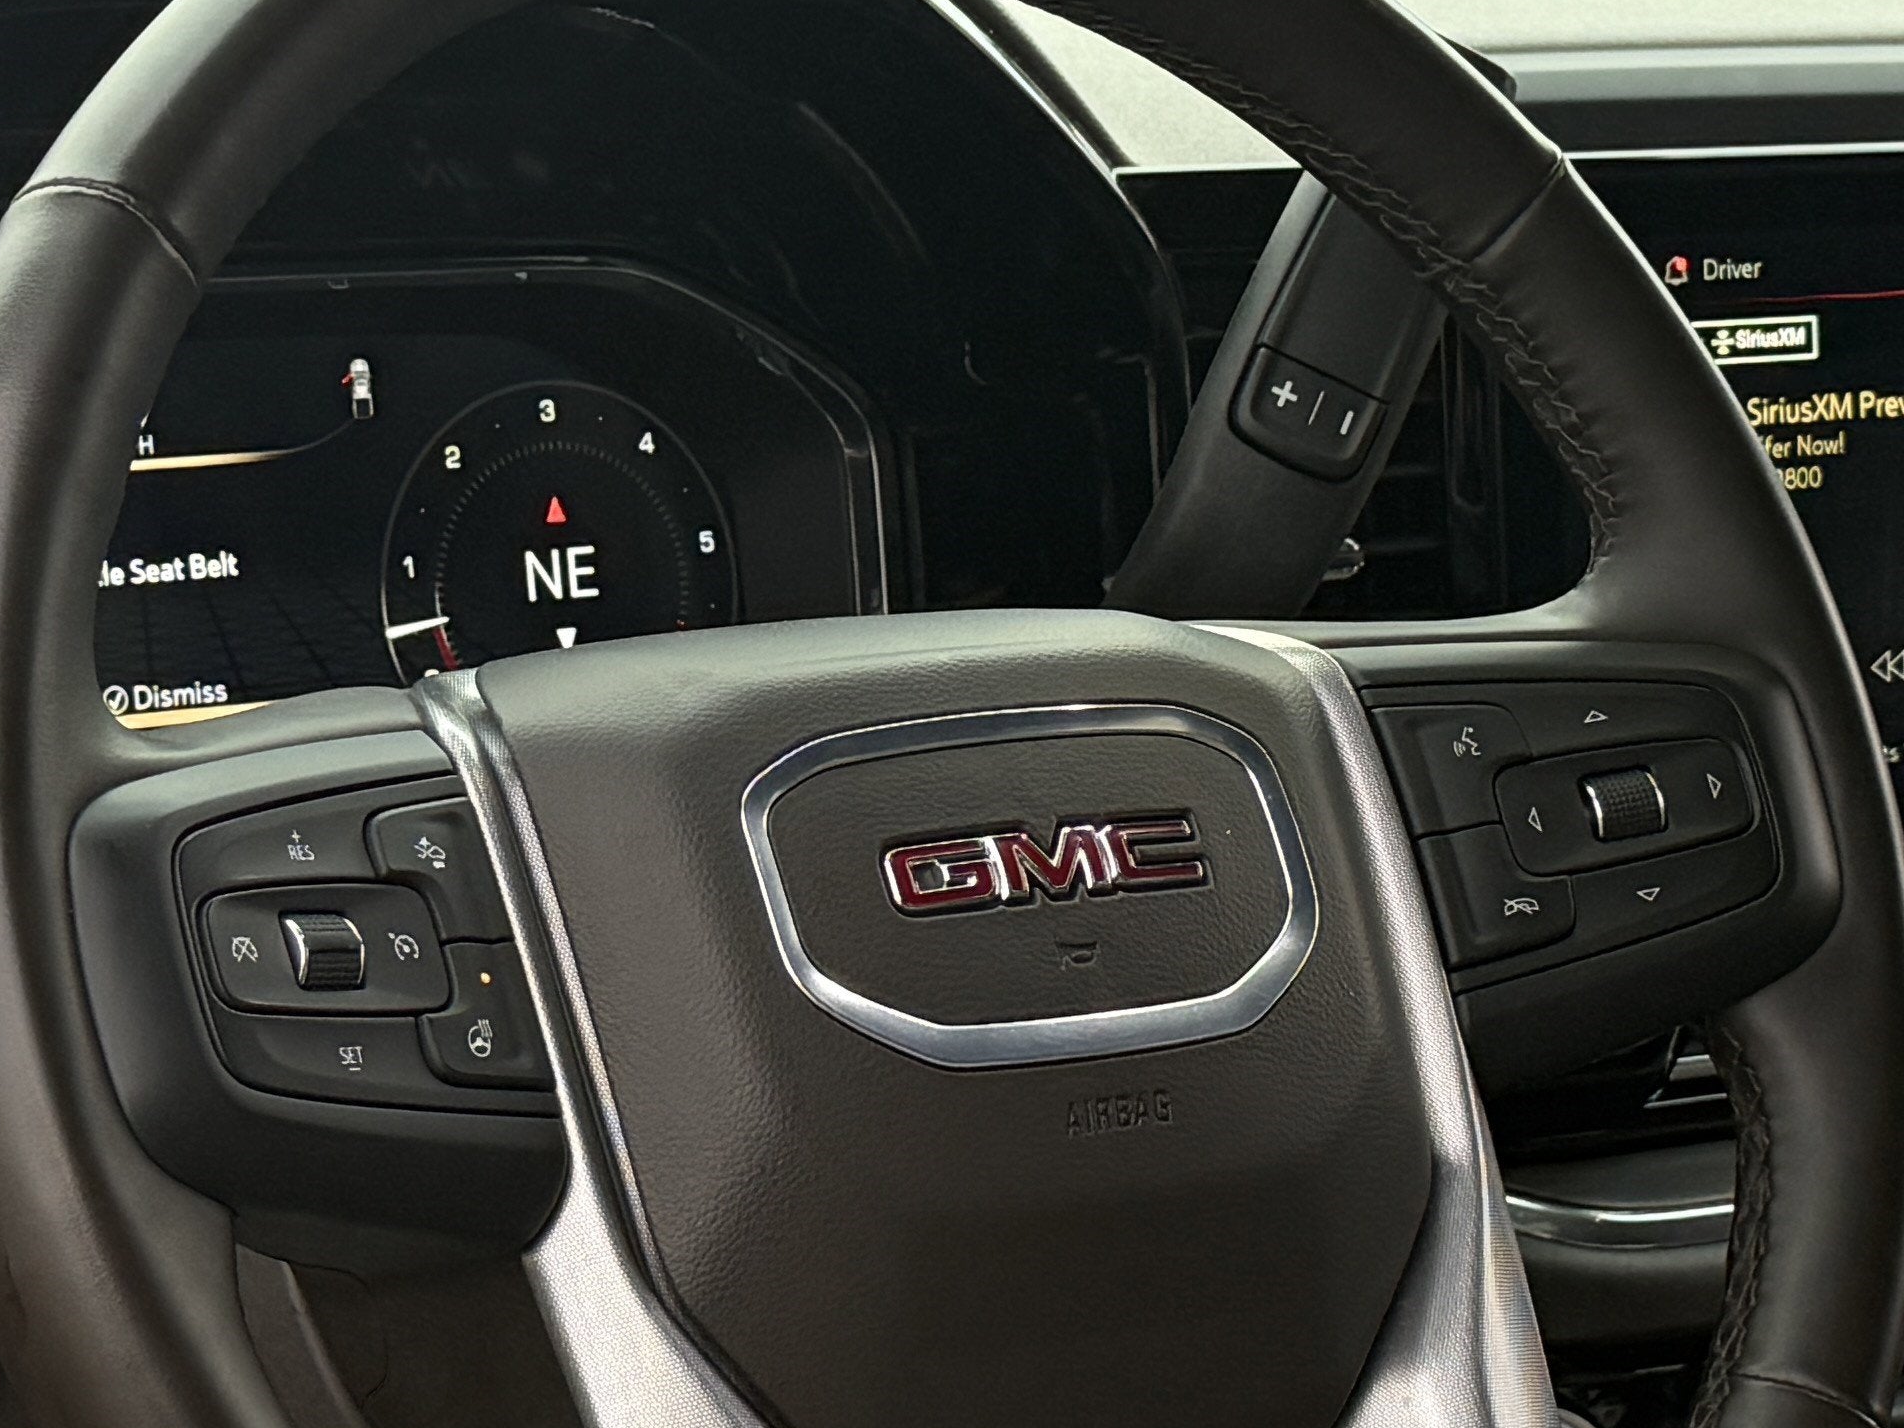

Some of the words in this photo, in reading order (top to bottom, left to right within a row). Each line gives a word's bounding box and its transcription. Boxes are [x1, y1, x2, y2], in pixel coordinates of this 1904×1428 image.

[1702, 258, 1763, 281] Driver
[1735, 326, 1806, 349] SiriusXM
[538, 399, 556, 423] 3
[1747, 391, 1853, 427] SiriusXM
[638, 432, 656, 455] 4
[1759, 435, 1791, 458] fer
[1797, 431, 1846, 455] Now!
[445, 446, 461, 469] 2
[698, 529, 716, 554] 5
[99, 559, 125, 587] le
[129, 557, 185, 585] Seat
[188, 550, 240, 580] Belt
[402, 555, 416, 579] 1
[523, 544, 600, 603] NE
[133, 681, 228, 711] Dismiss
[287, 844, 315, 862] RES
[884, 818, 1204, 909] GMC
[339, 1045, 364, 1065] SET
[1065, 1088, 1174, 1138] AIRBAG
